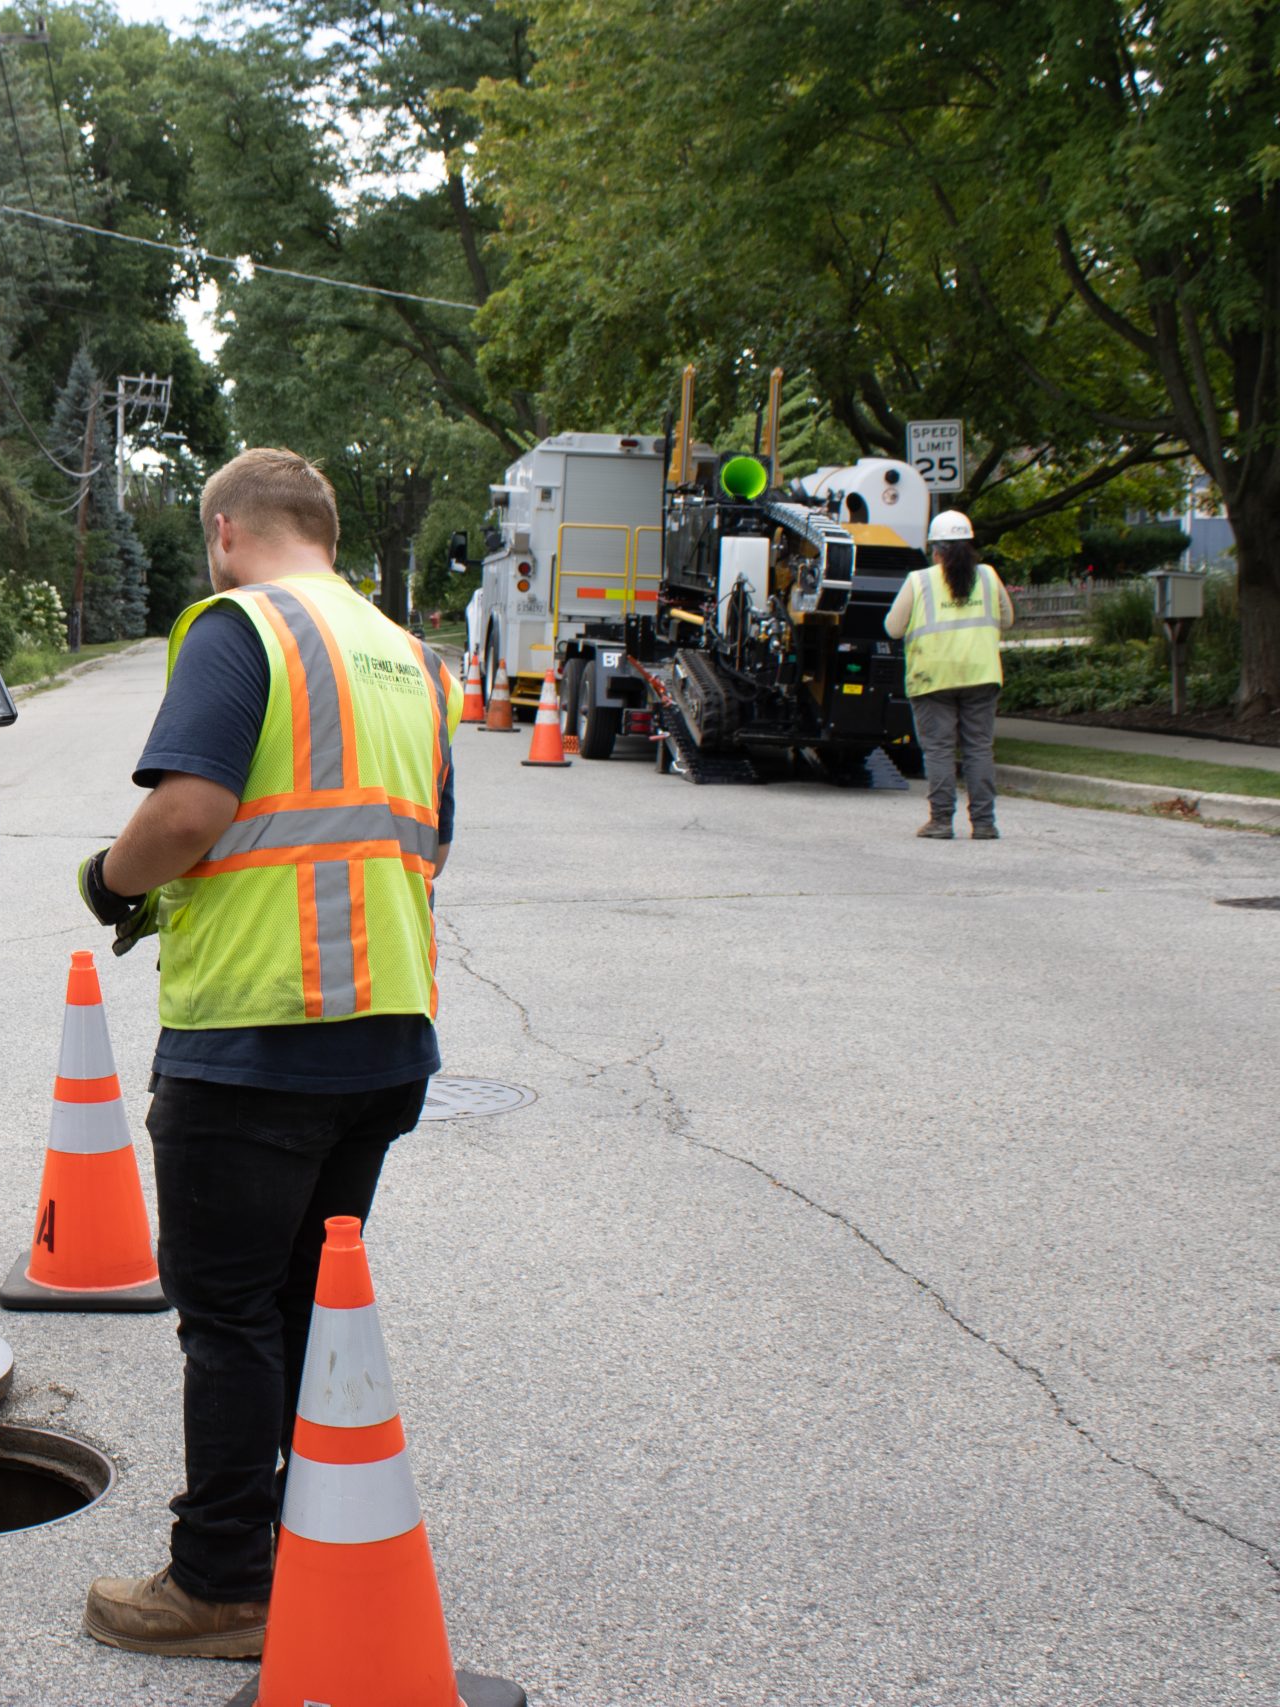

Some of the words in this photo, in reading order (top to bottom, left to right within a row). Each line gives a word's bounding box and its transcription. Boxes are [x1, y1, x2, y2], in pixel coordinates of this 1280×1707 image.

[913, 426, 958, 439] SPEED
[918, 441, 953, 452] LIMIT
[915, 457, 958, 482] 25
[36, 1198, 56, 1254] A
